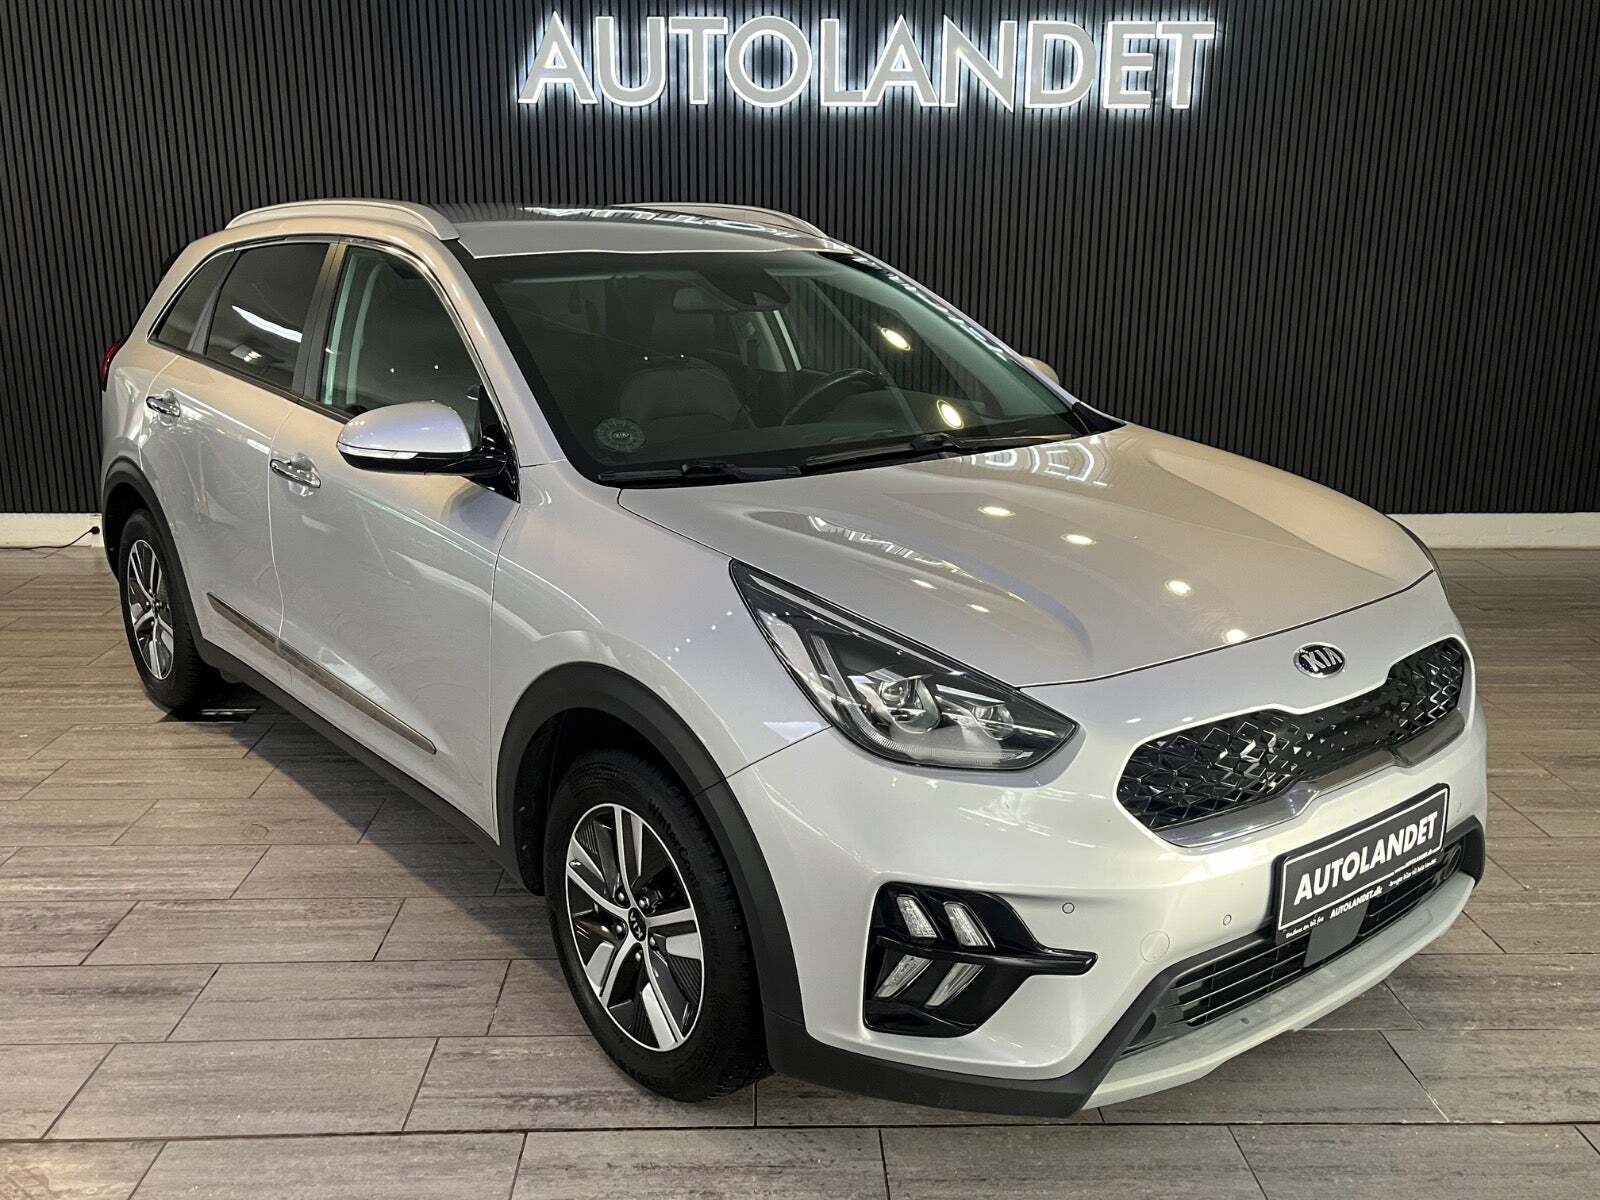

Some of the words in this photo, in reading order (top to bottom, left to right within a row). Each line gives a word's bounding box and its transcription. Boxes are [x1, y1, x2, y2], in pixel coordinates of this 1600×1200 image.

[517, 11, 1215, 112] AUTOLANDET
[1301, 646, 1343, 672] KIA
[1293, 811, 1439, 906] AUTOLANDET
